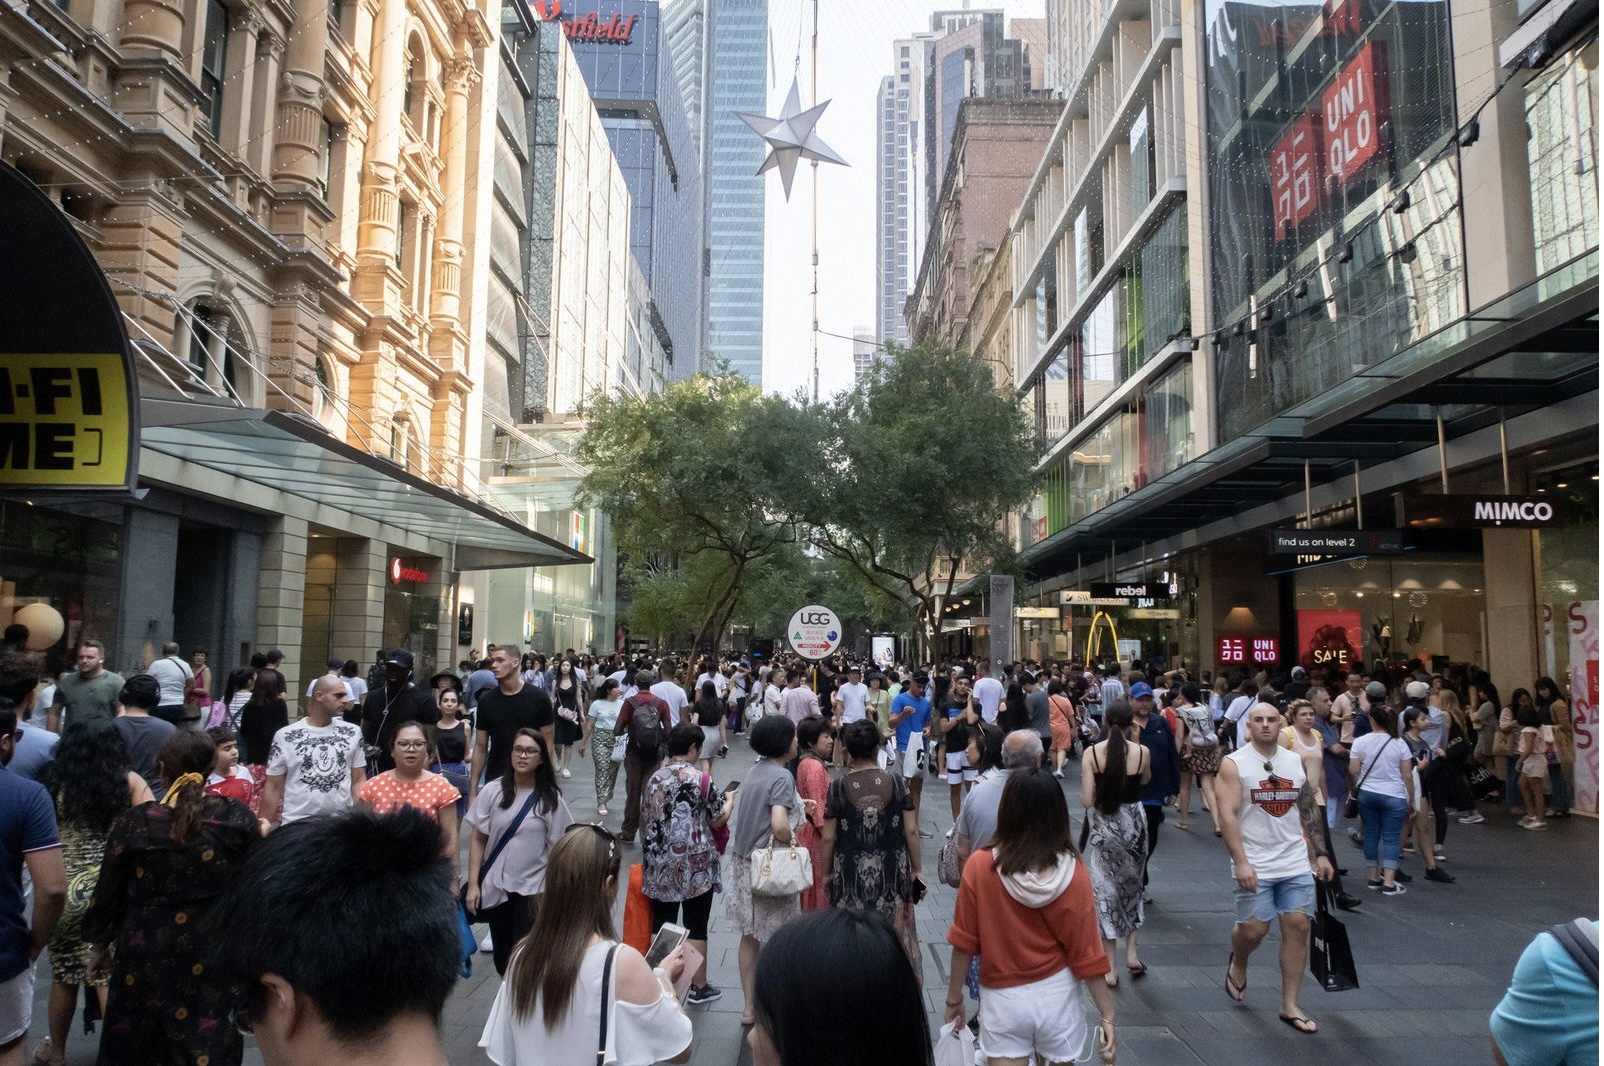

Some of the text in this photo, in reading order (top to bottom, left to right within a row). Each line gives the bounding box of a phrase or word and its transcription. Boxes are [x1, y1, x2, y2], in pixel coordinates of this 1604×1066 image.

[1327, 68, 1364, 132] UNI
[1330, 110, 1370, 176] QLO
[1474, 501, 1553, 526] MIMCO
[1278, 537, 1355, 547] find us on level 2
[1115, 585, 1146, 596] rebel
[800, 612, 830, 625] UGG
[1222, 639, 1242, 649] ユニ
[1254, 639, 1274, 650] UNI
[1254, 651, 1276, 662] QLO
